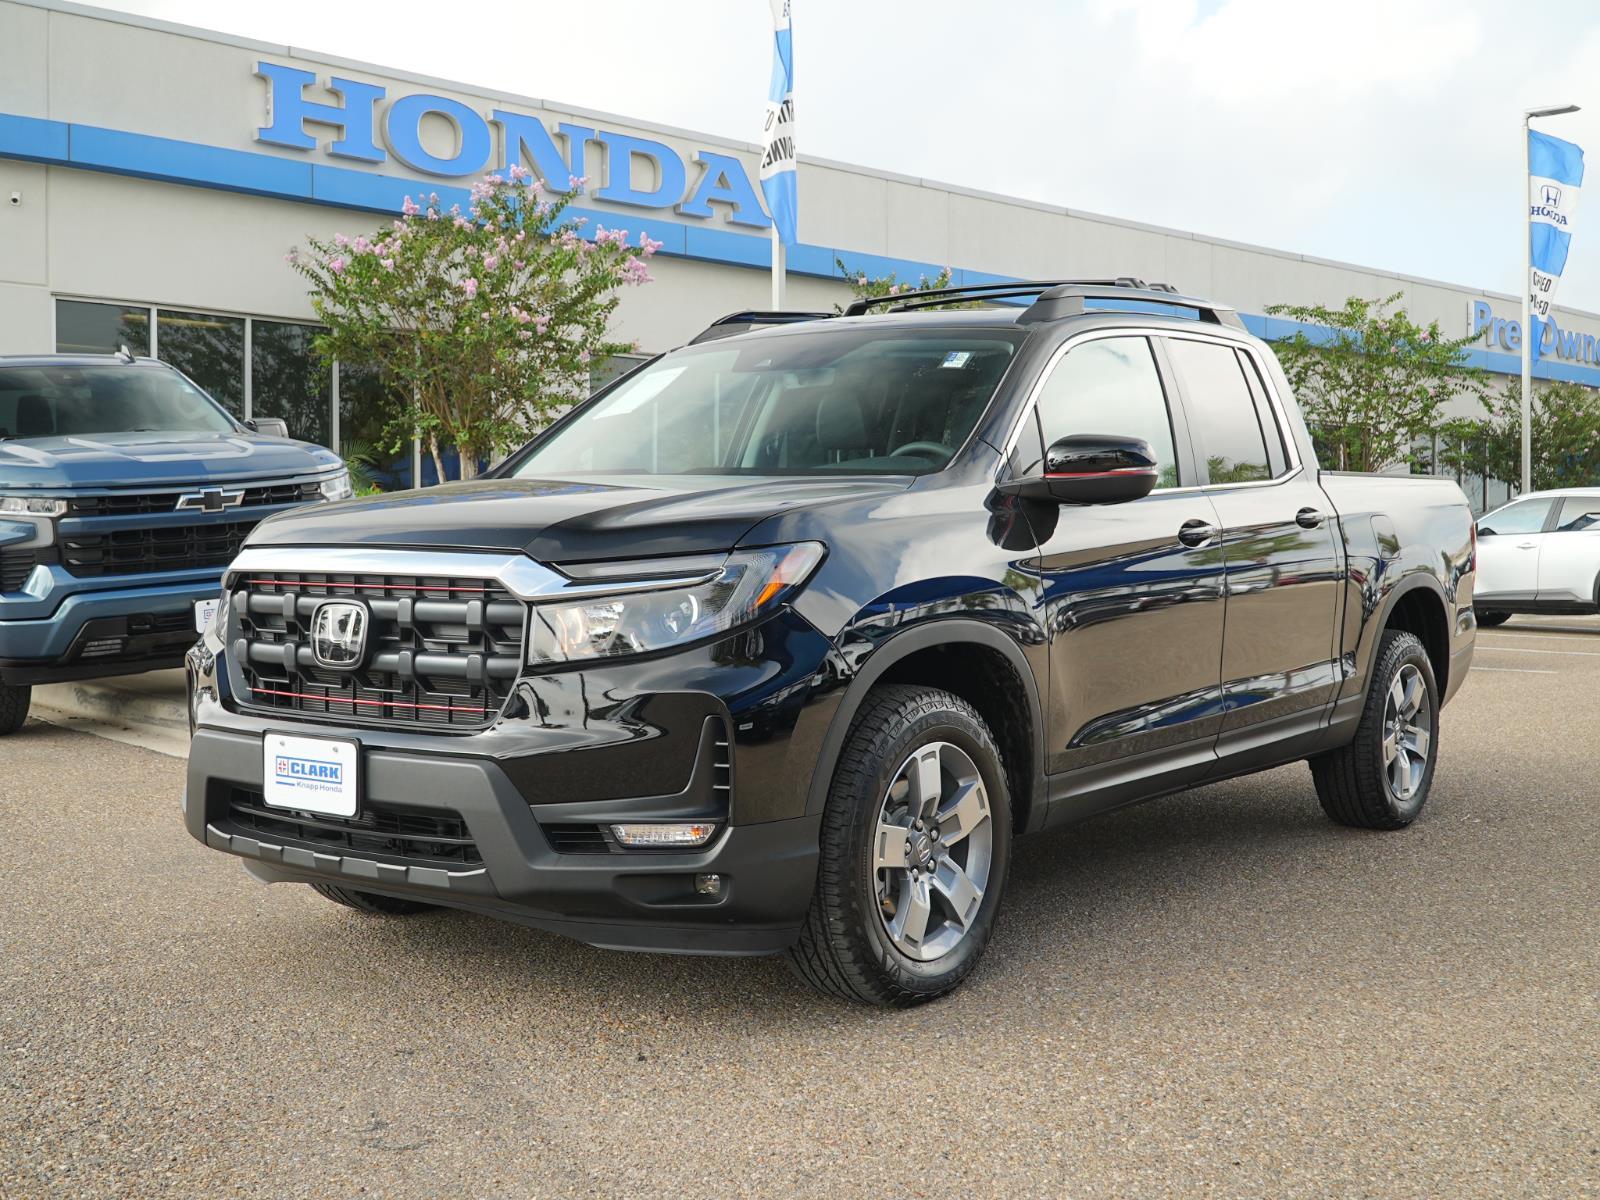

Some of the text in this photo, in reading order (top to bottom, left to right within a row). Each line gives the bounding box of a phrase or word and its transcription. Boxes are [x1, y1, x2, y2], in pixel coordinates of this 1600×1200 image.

[254, 61, 773, 229] HONDA
[1531, 206, 1568, 225] HONDA
[290, 762, 339, 779] CLARK
[296, 782, 342, 793] Knapp Honda
